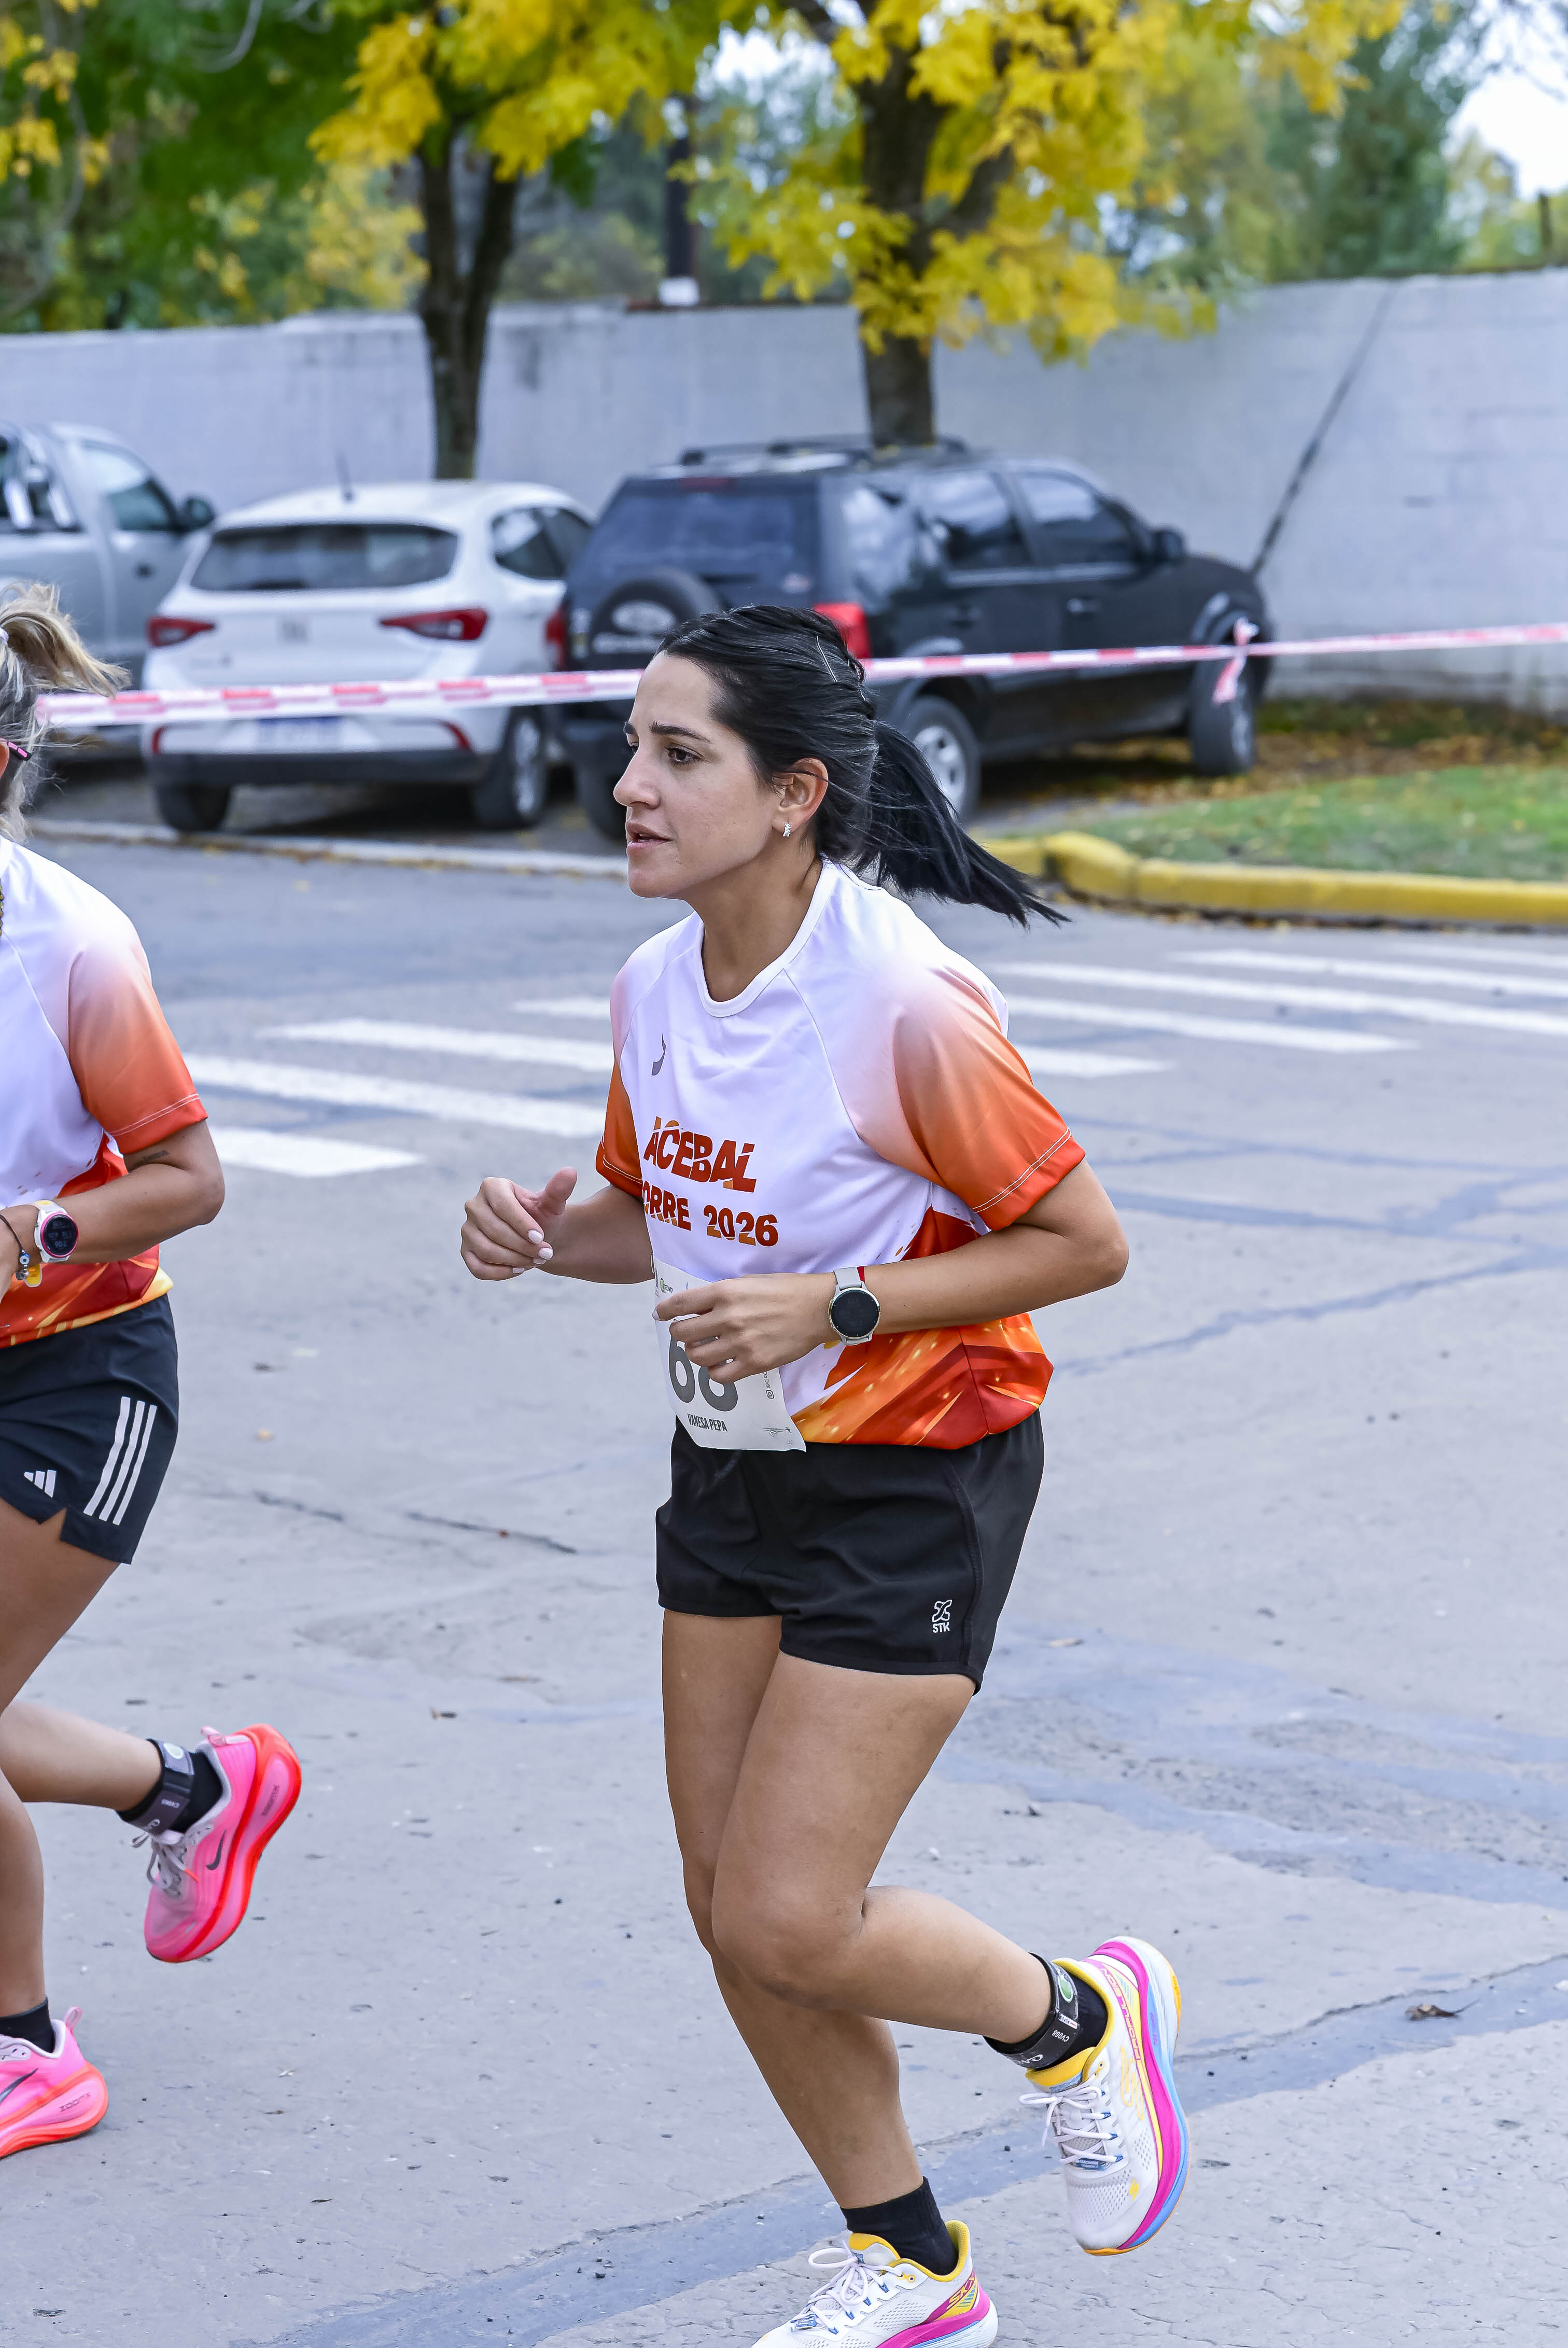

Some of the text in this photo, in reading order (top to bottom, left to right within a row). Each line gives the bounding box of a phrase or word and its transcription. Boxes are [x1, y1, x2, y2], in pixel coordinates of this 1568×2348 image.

[643, 1116, 757, 1193] ACEBAL
[642, 1180, 779, 1247] ORRE 2026
[687, 1413, 729, 1432] VANESA PEPA
[932, 1622, 950, 1633] STK
